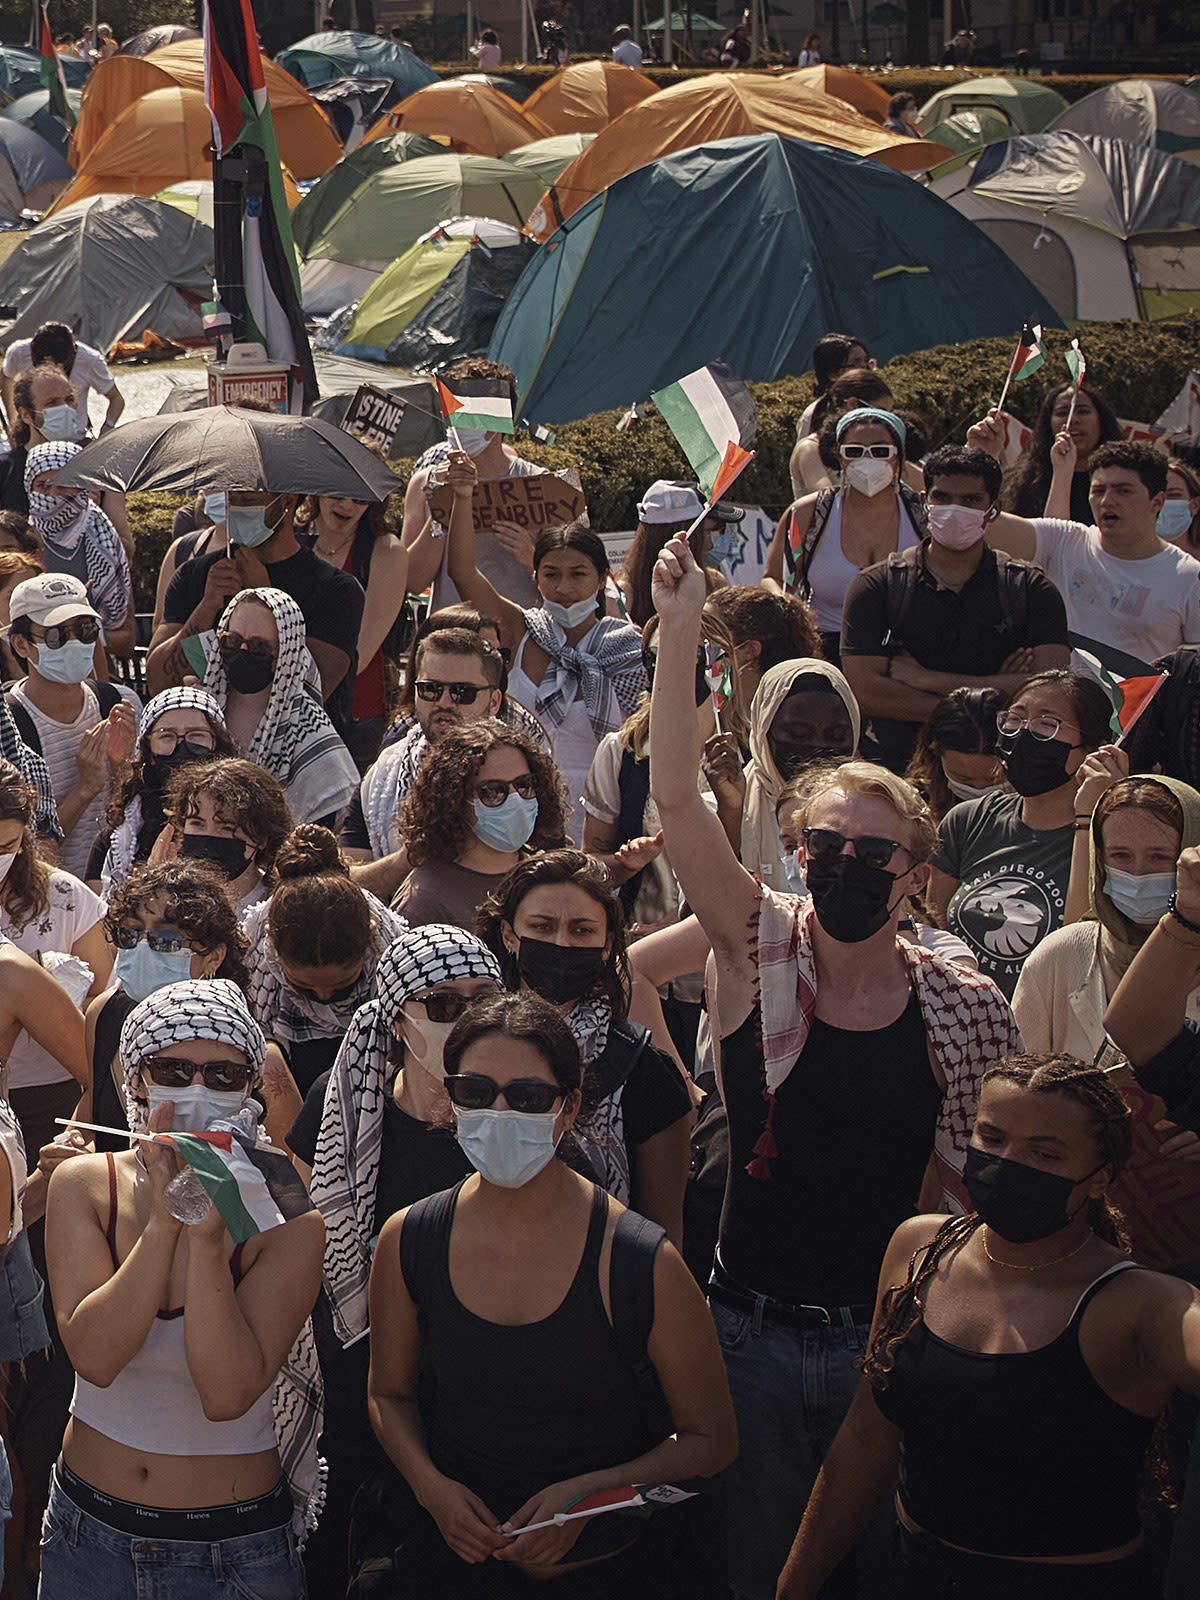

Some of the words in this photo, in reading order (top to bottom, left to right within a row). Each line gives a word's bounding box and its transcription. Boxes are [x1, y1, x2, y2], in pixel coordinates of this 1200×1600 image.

[224, 380, 282, 402] EMERGENCY
[430, 496, 579, 530] RSENBURY
[963, 871, 992, 891] SAN
[999, 863, 1045, 880] DIEGO
[1045, 879, 1065, 908] ZOO
[93, 1492, 113, 1507] Hanes
[136, 1508, 160, 1519] Hanes
[186, 1512, 211, 1520] Hanes
[236, 1503, 259, 1514] Hanes
